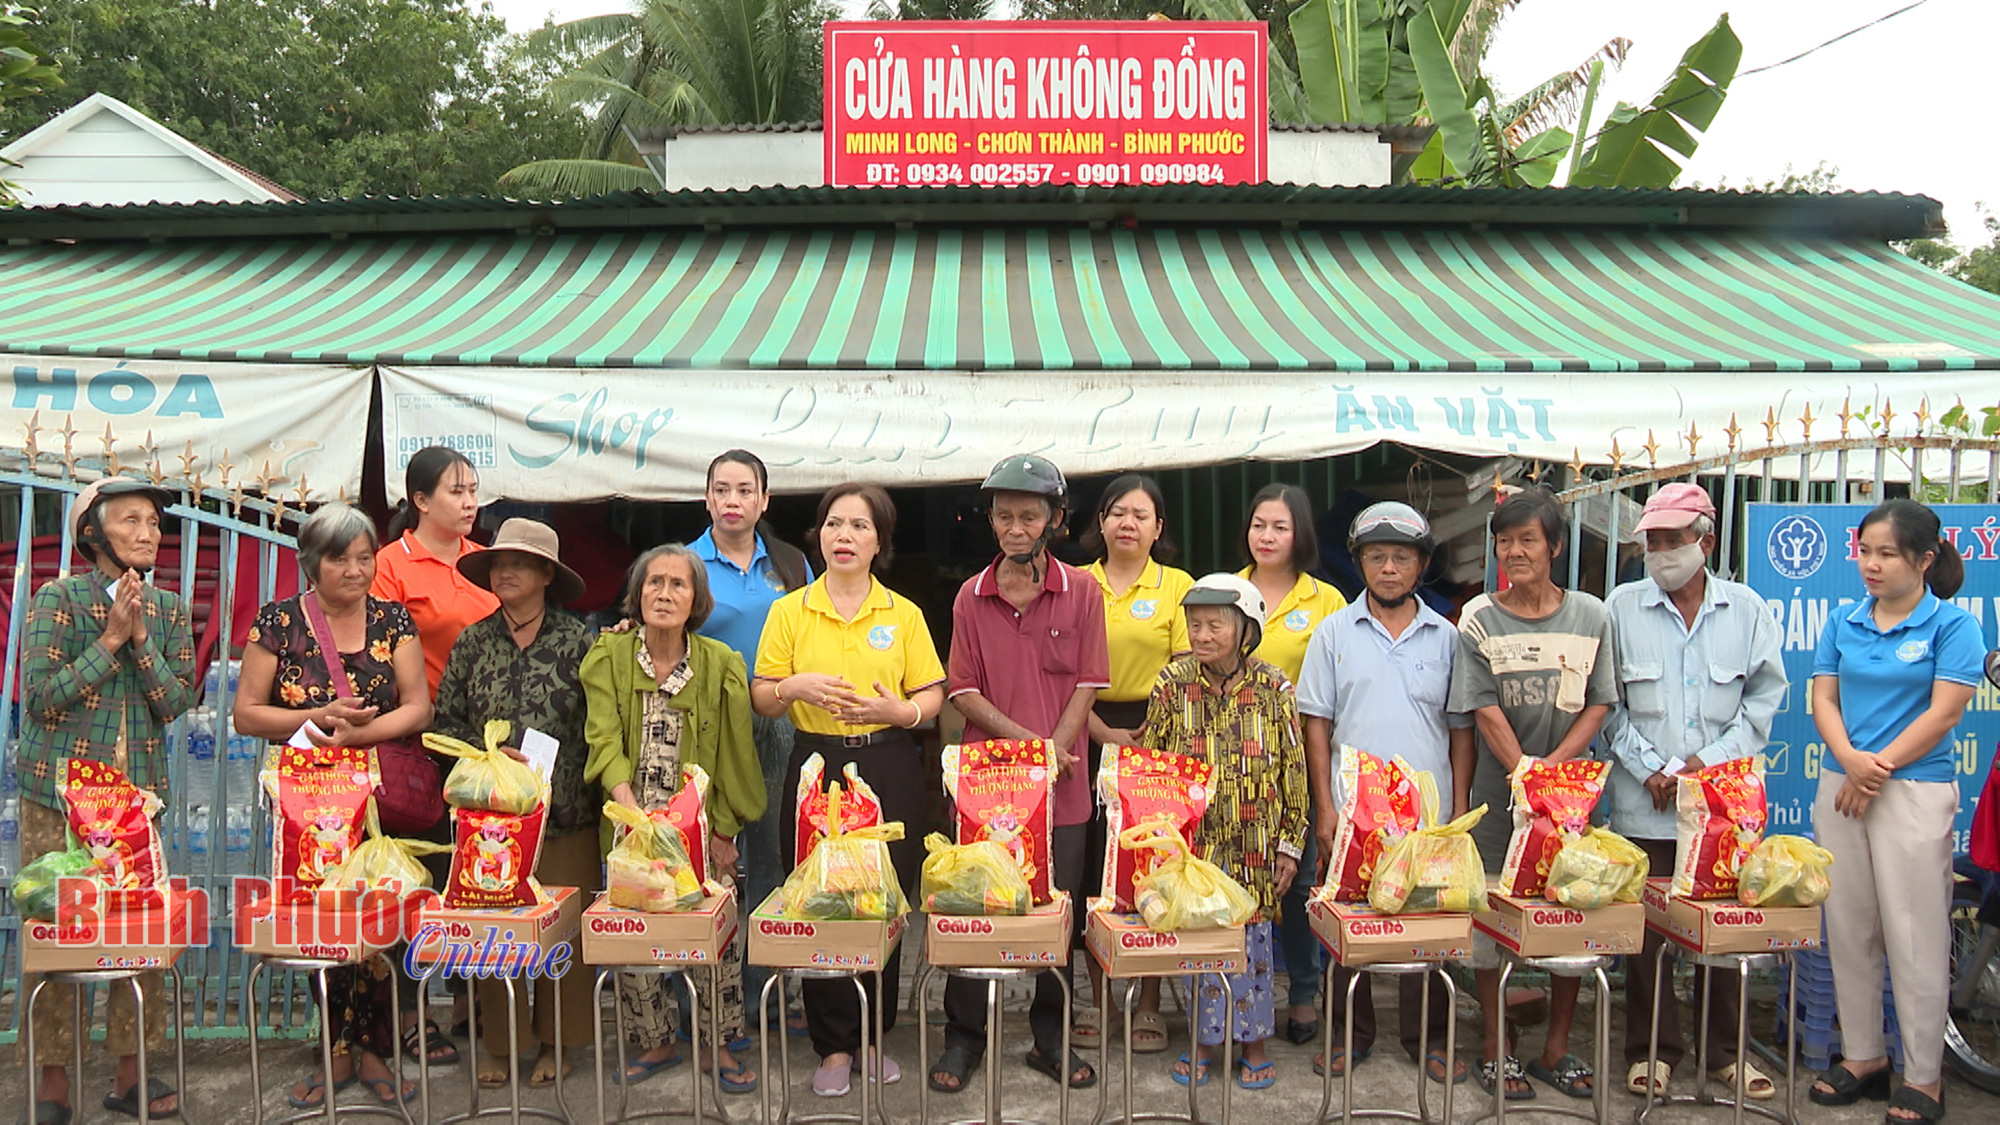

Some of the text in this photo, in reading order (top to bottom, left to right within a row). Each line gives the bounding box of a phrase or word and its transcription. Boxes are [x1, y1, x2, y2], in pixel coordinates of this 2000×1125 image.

[845, 36, 1246, 120] CỬA HÀNG KHÔNG ĐỒNG
[845, 132, 899, 154] MINH
[905, 132, 957, 154] LONG
[977, 130, 1032, 154] CHƠN
[1038, 128, 1104, 154] THÀNH
[1124, 128, 1172, 154] BÌNH
[1178, 128, 1245, 154] PHƯỚC
[867, 163, 900, 183] ĐT:
[907, 163, 963, 183] 0934
[970, 163, 1054, 183] 002557
[1077, 163, 1130, 183] 0901
[1140, 163, 1225, 183] 090984
[12, 360, 225, 419] HÓA
[1331, 384, 1420, 433] ĂN
[1433, 386, 1557, 452] VẶT
[508, 386, 680, 470] Shop
